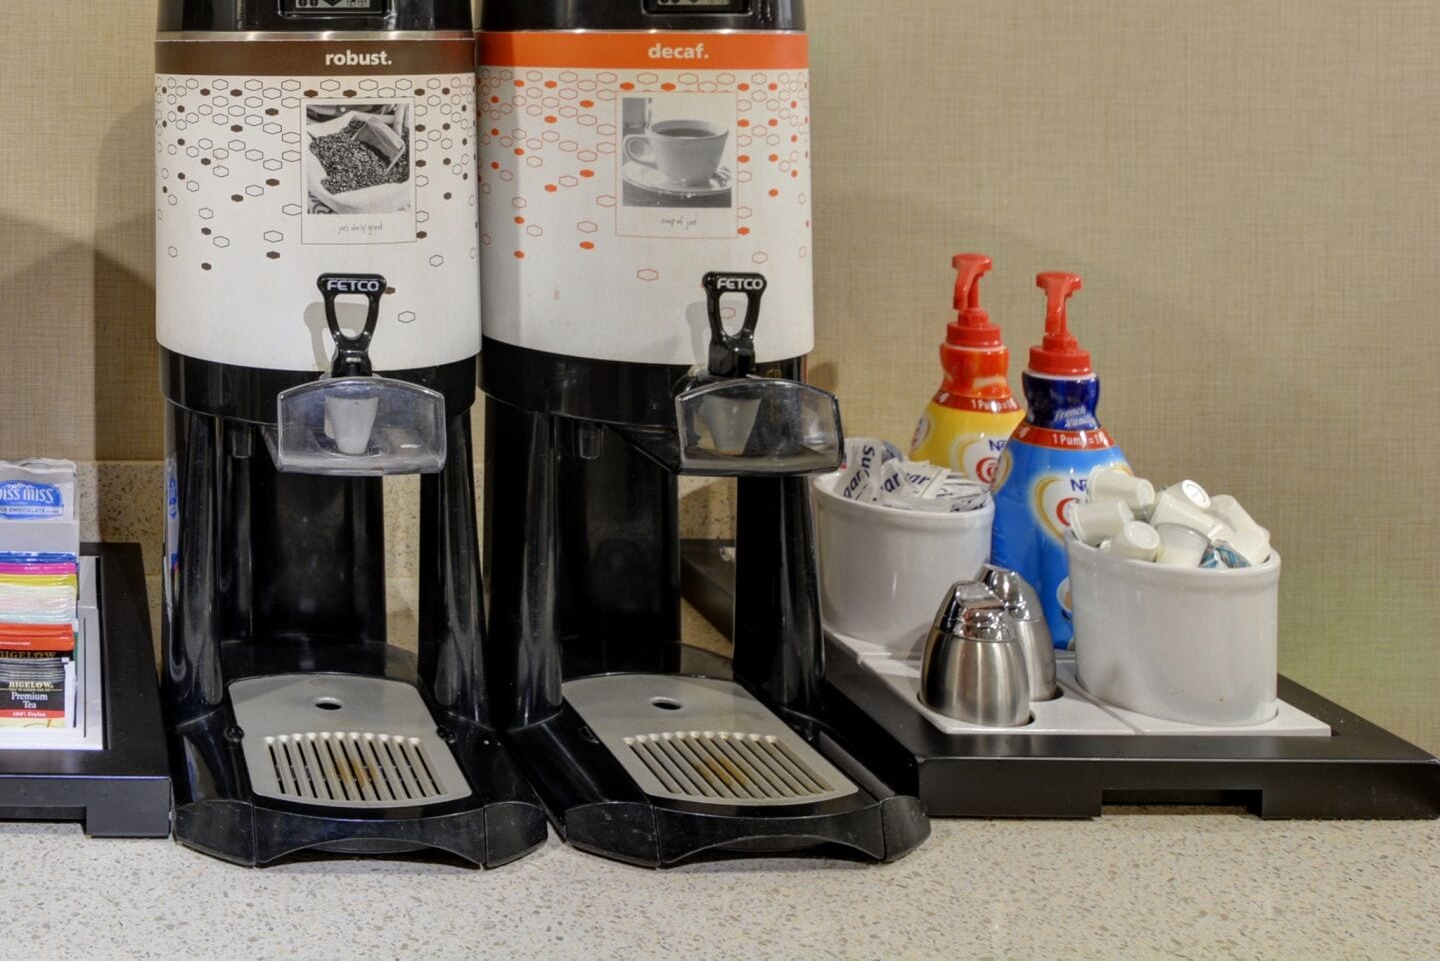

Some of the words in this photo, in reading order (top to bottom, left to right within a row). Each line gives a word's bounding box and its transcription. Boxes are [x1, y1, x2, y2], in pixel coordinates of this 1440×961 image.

[647, 42, 709, 59] decaf.
[325, 49, 392, 66] robust.
[326, 280, 380, 292] FETCO
[716, 278, 764, 291] FETCO
[1054, 404, 1087, 422] French
[23, 487, 54, 504] MISS
[8, 680, 51, 690] BIGELOW
[10, 691, 49, 702] Premium
[22, 700, 38, 709] Tea
